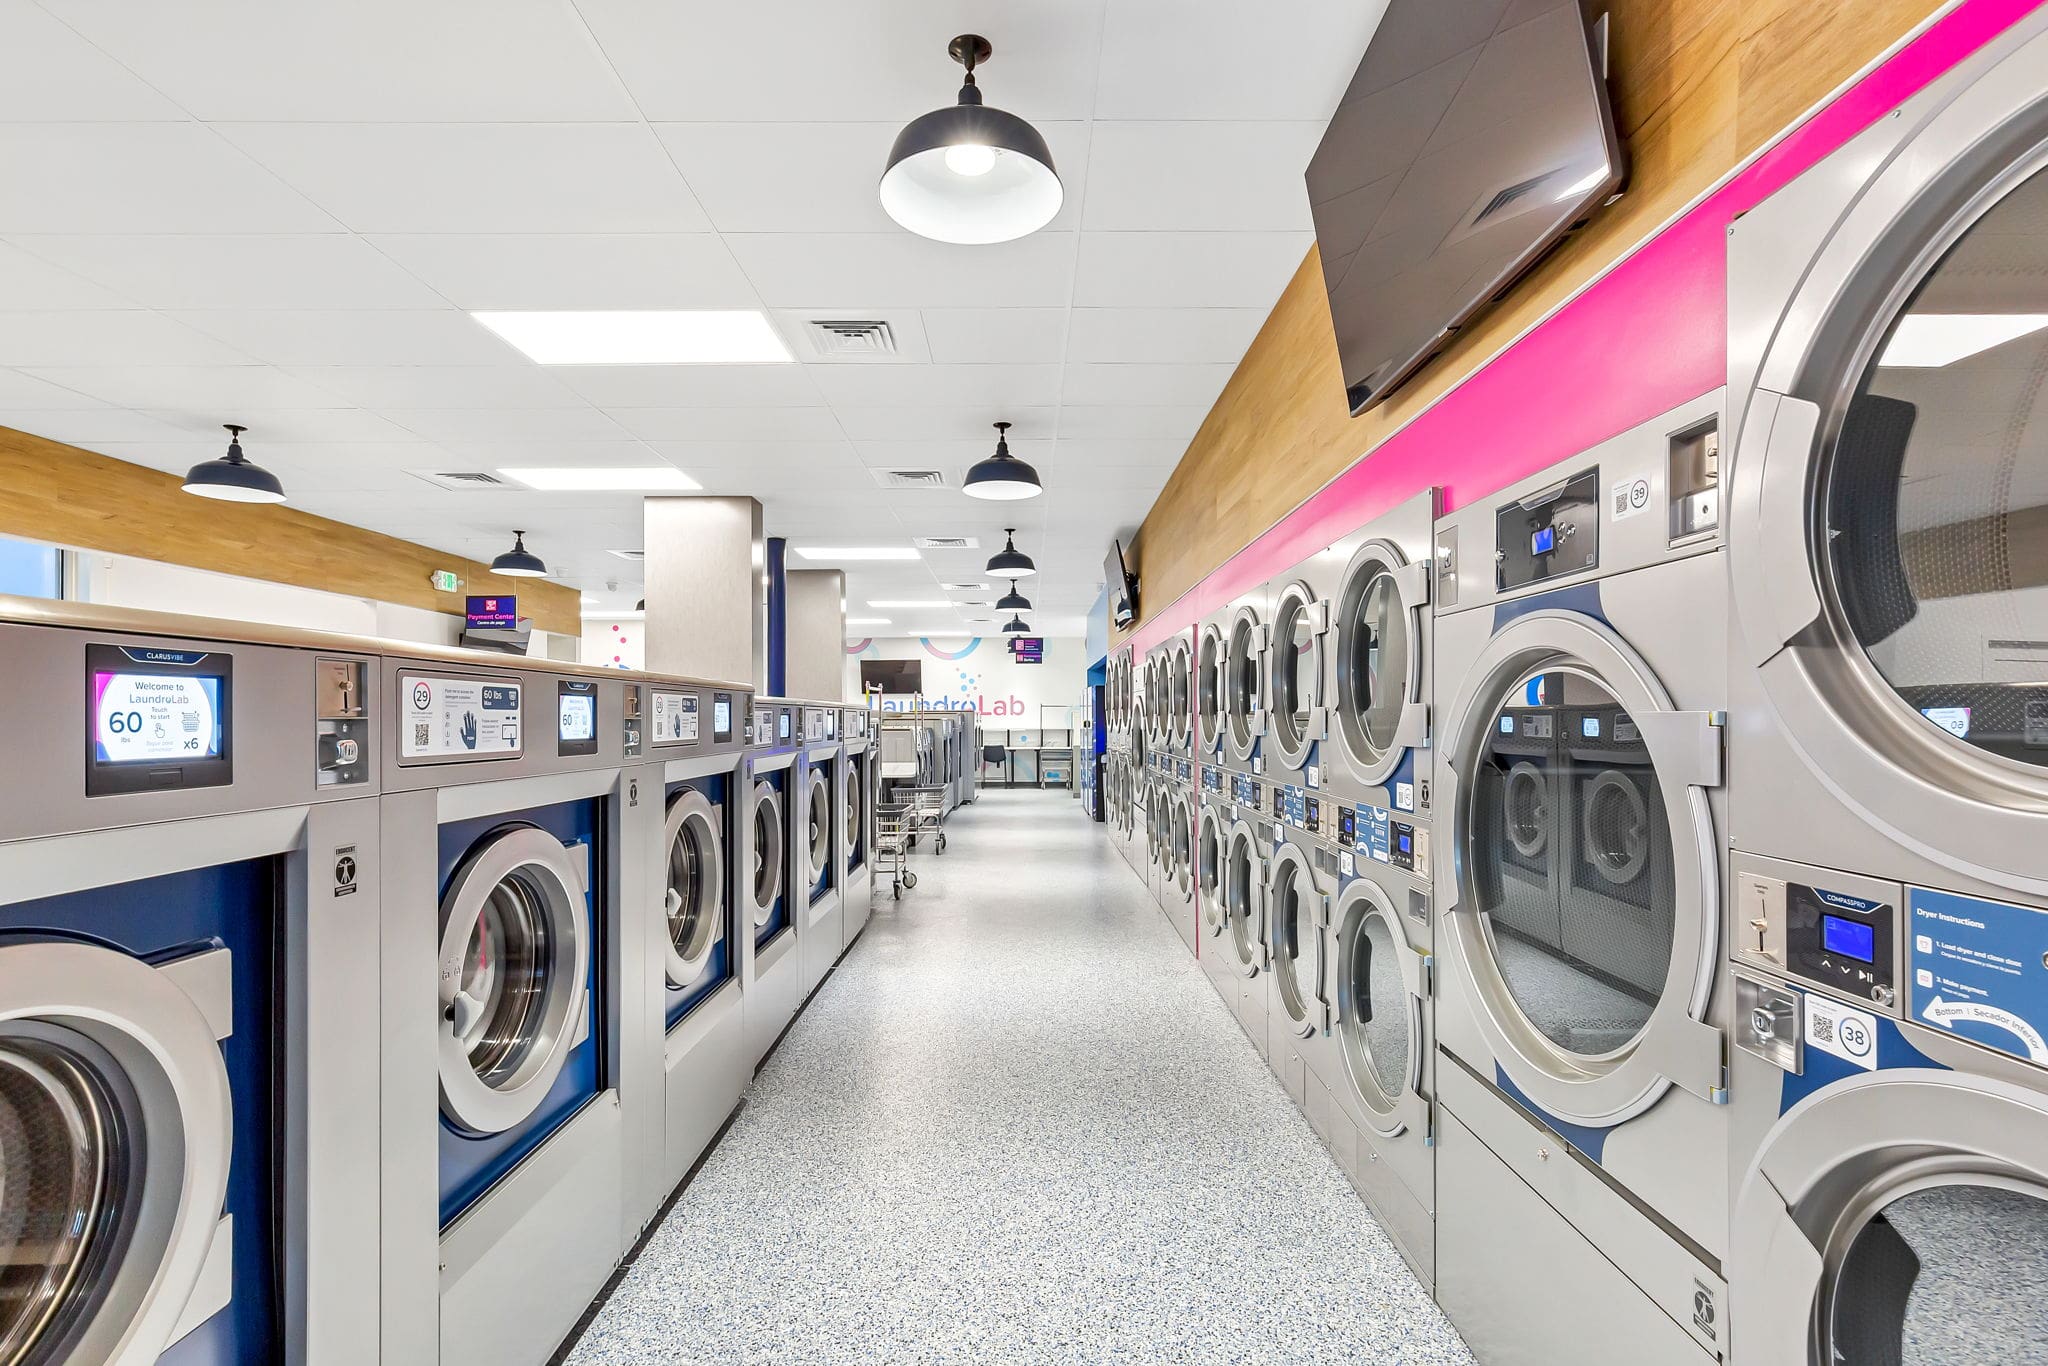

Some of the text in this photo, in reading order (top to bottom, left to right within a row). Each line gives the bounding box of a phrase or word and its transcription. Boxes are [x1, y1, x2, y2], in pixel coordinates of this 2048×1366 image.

[1633, 487, 1645, 500] 39
[134, 681, 184, 691] Welcome to
[129, 694, 189, 704] LaundroLab
[416, 690, 428, 702] 29
[484, 689, 493, 699] 60
[109, 711, 143, 733] 60
[562, 714, 573, 726] 60
[183, 737, 199, 750] x6
[1826, 894, 1866, 909] COMPASSPRO
[1916, 907, 1985, 929] Dryer Instructions
[1941, 941, 1956, 951] Load
[1956, 946, 1973, 955] dryer
[1973, 951, 1987, 959] and
[1987, 954, 2005, 963] close
[1942, 978, 1959, 988] Make
[1934, 1008, 2041, 1050] Bottom Secador Inferior
[1844, 1026, 1865, 1046] 38
